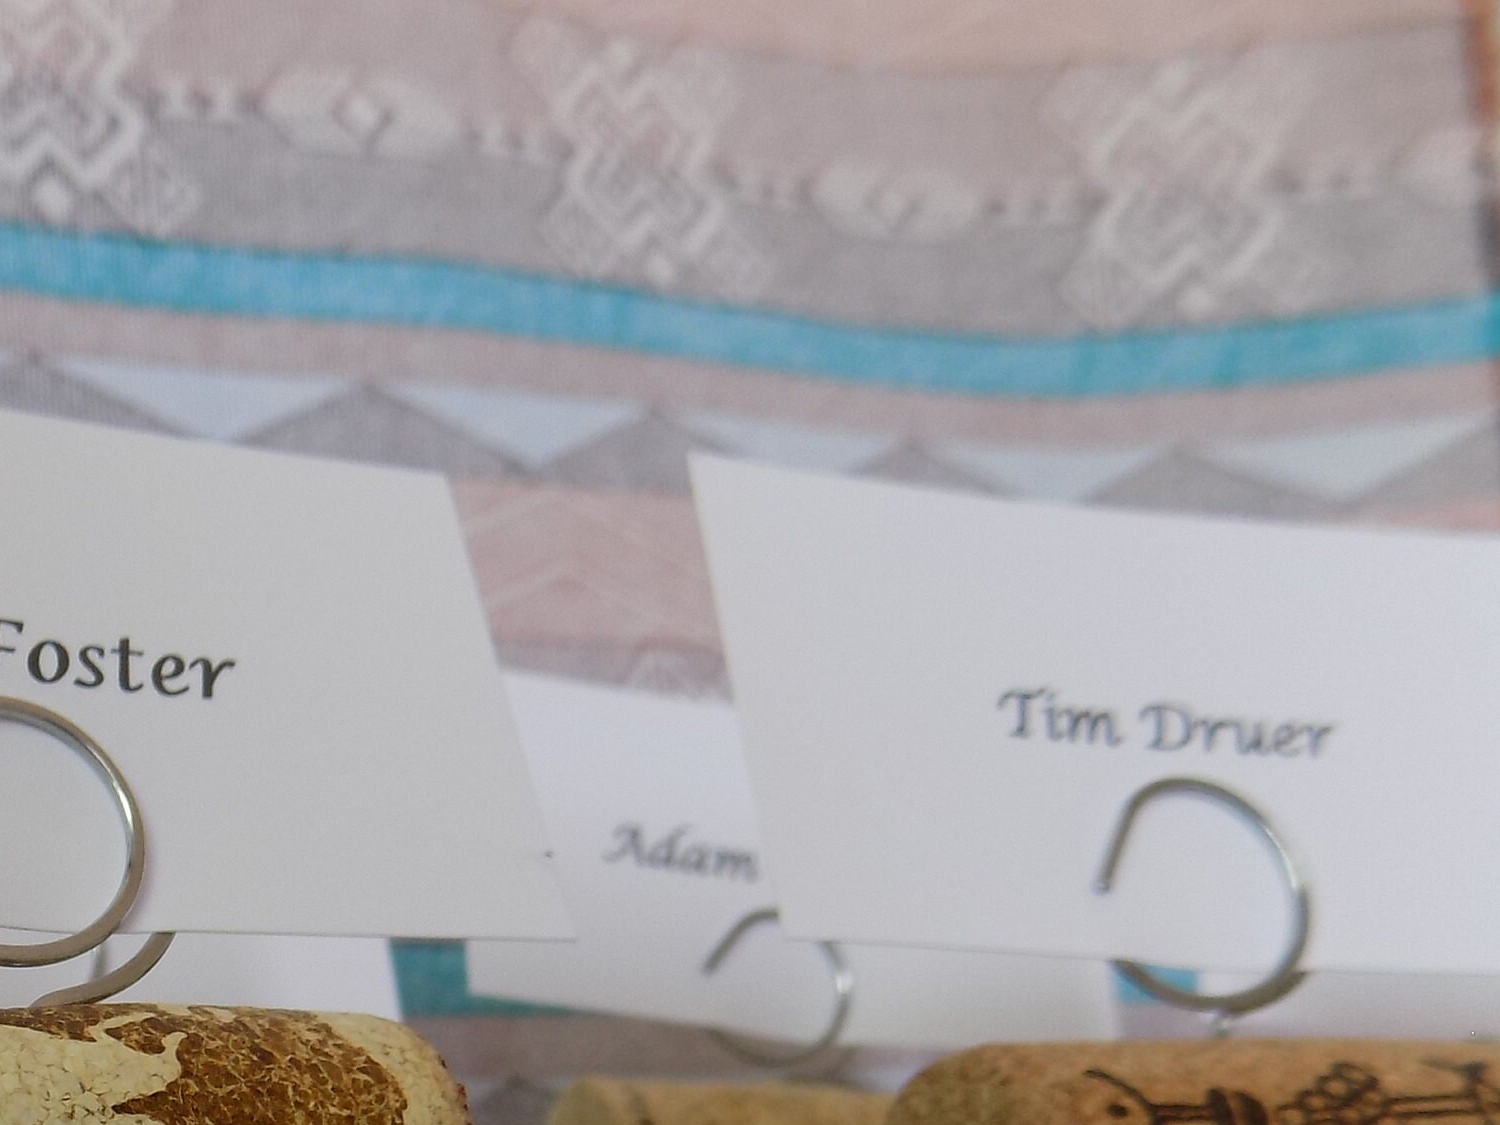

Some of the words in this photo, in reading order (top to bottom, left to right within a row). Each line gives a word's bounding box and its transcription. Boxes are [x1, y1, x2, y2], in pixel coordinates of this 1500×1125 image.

[997, 687, 1126, 748] Tim
[1140, 703, 1336, 759] Druer
[601, 819, 761, 885] Adam
